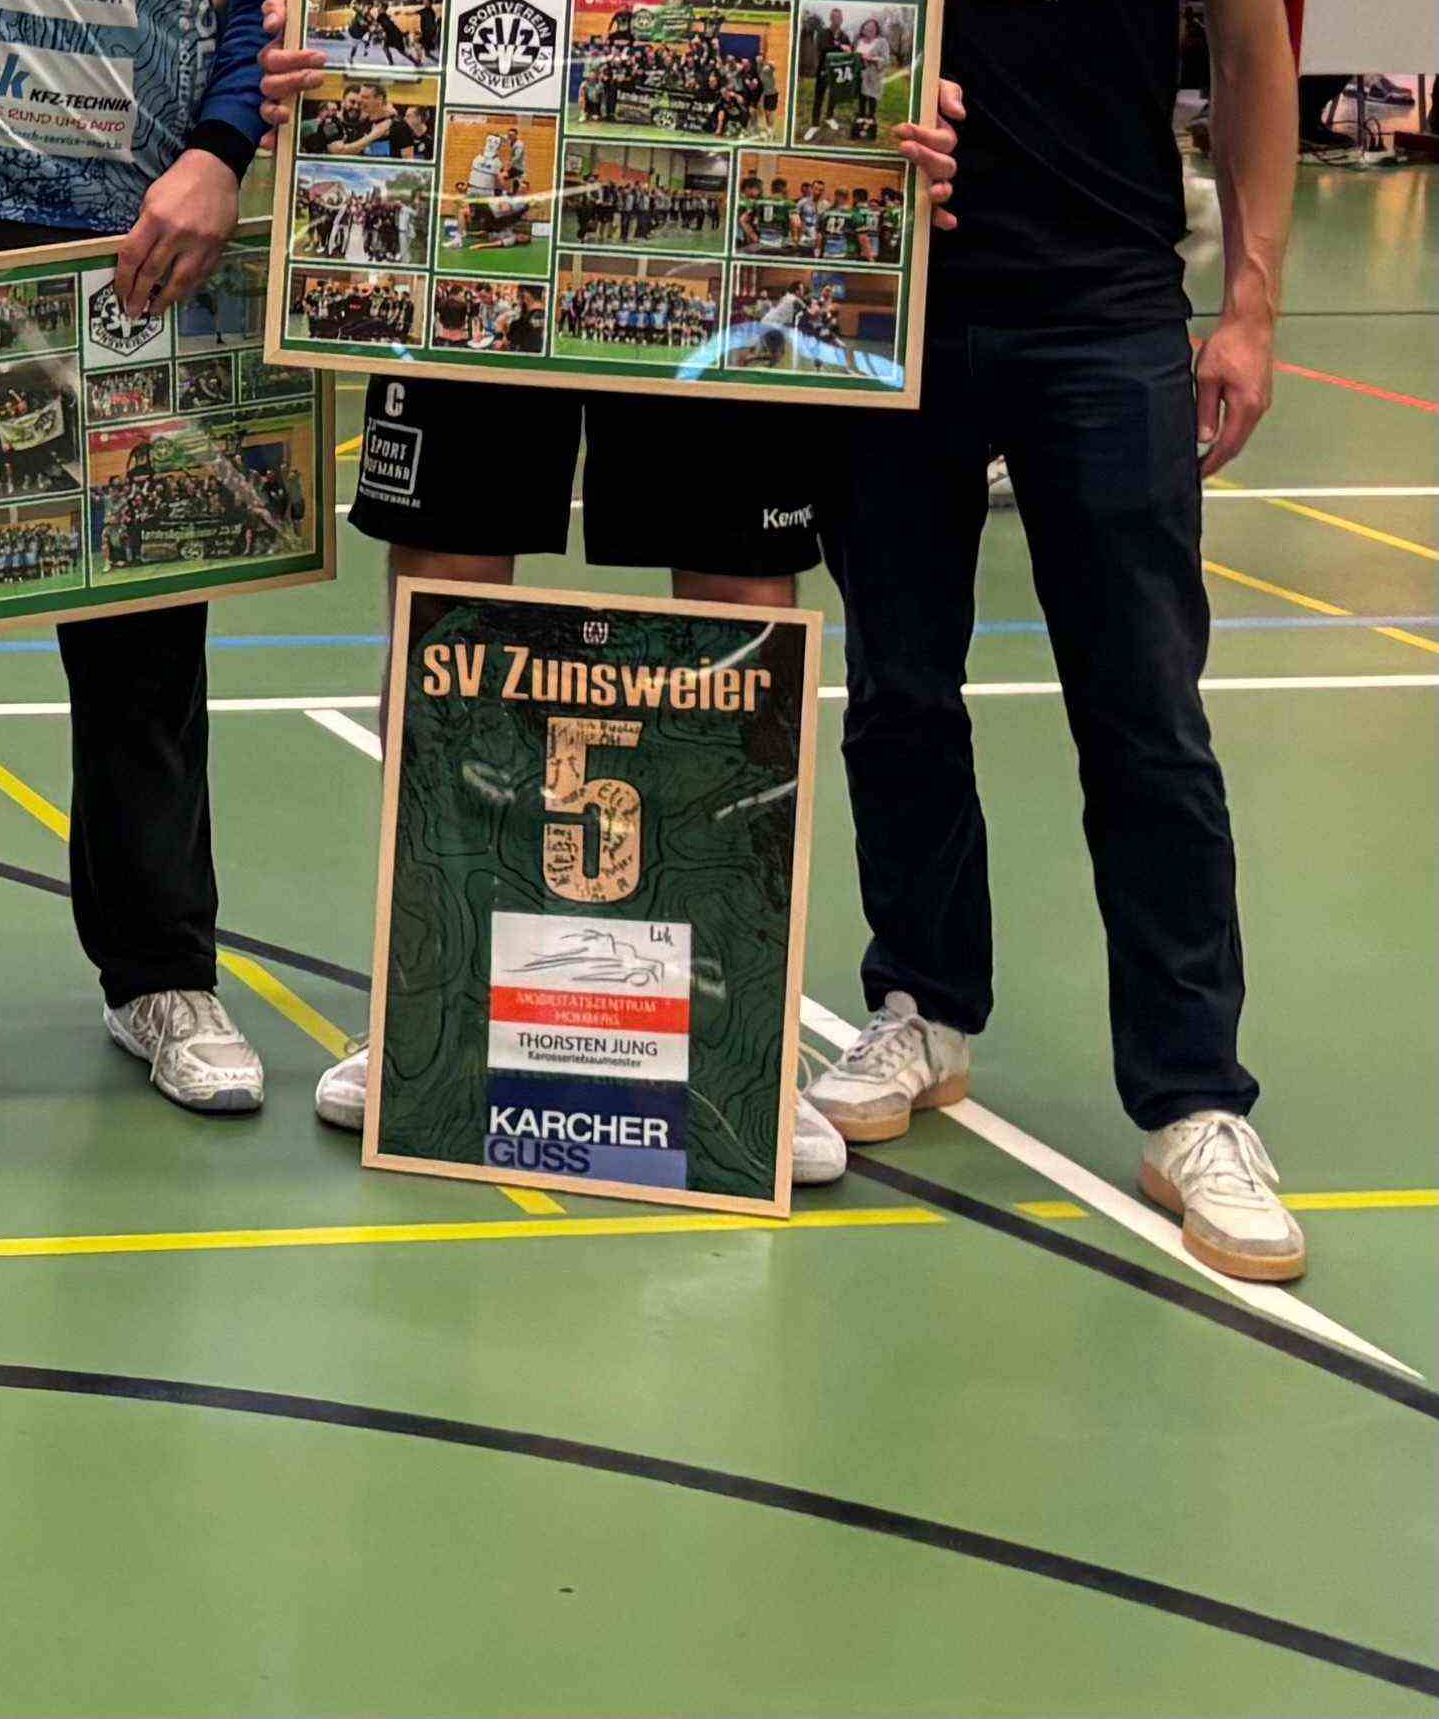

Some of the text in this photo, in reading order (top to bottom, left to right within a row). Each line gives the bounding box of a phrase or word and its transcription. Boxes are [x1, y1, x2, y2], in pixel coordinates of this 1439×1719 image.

[29, 88, 132, 114] KFZ-TECHNIK
[385, 382, 405, 417] C
[422, 643, 772, 713] SV Zunsweier
[543, 716, 646, 904] 5
[517, 1032, 659, 1058] THORSTEN JUNG
[527, 1050, 644, 1070] Karosseriebaumeister
[489, 1105, 670, 1149] KARCHER
[486, 1138, 591, 1174] GUSS
